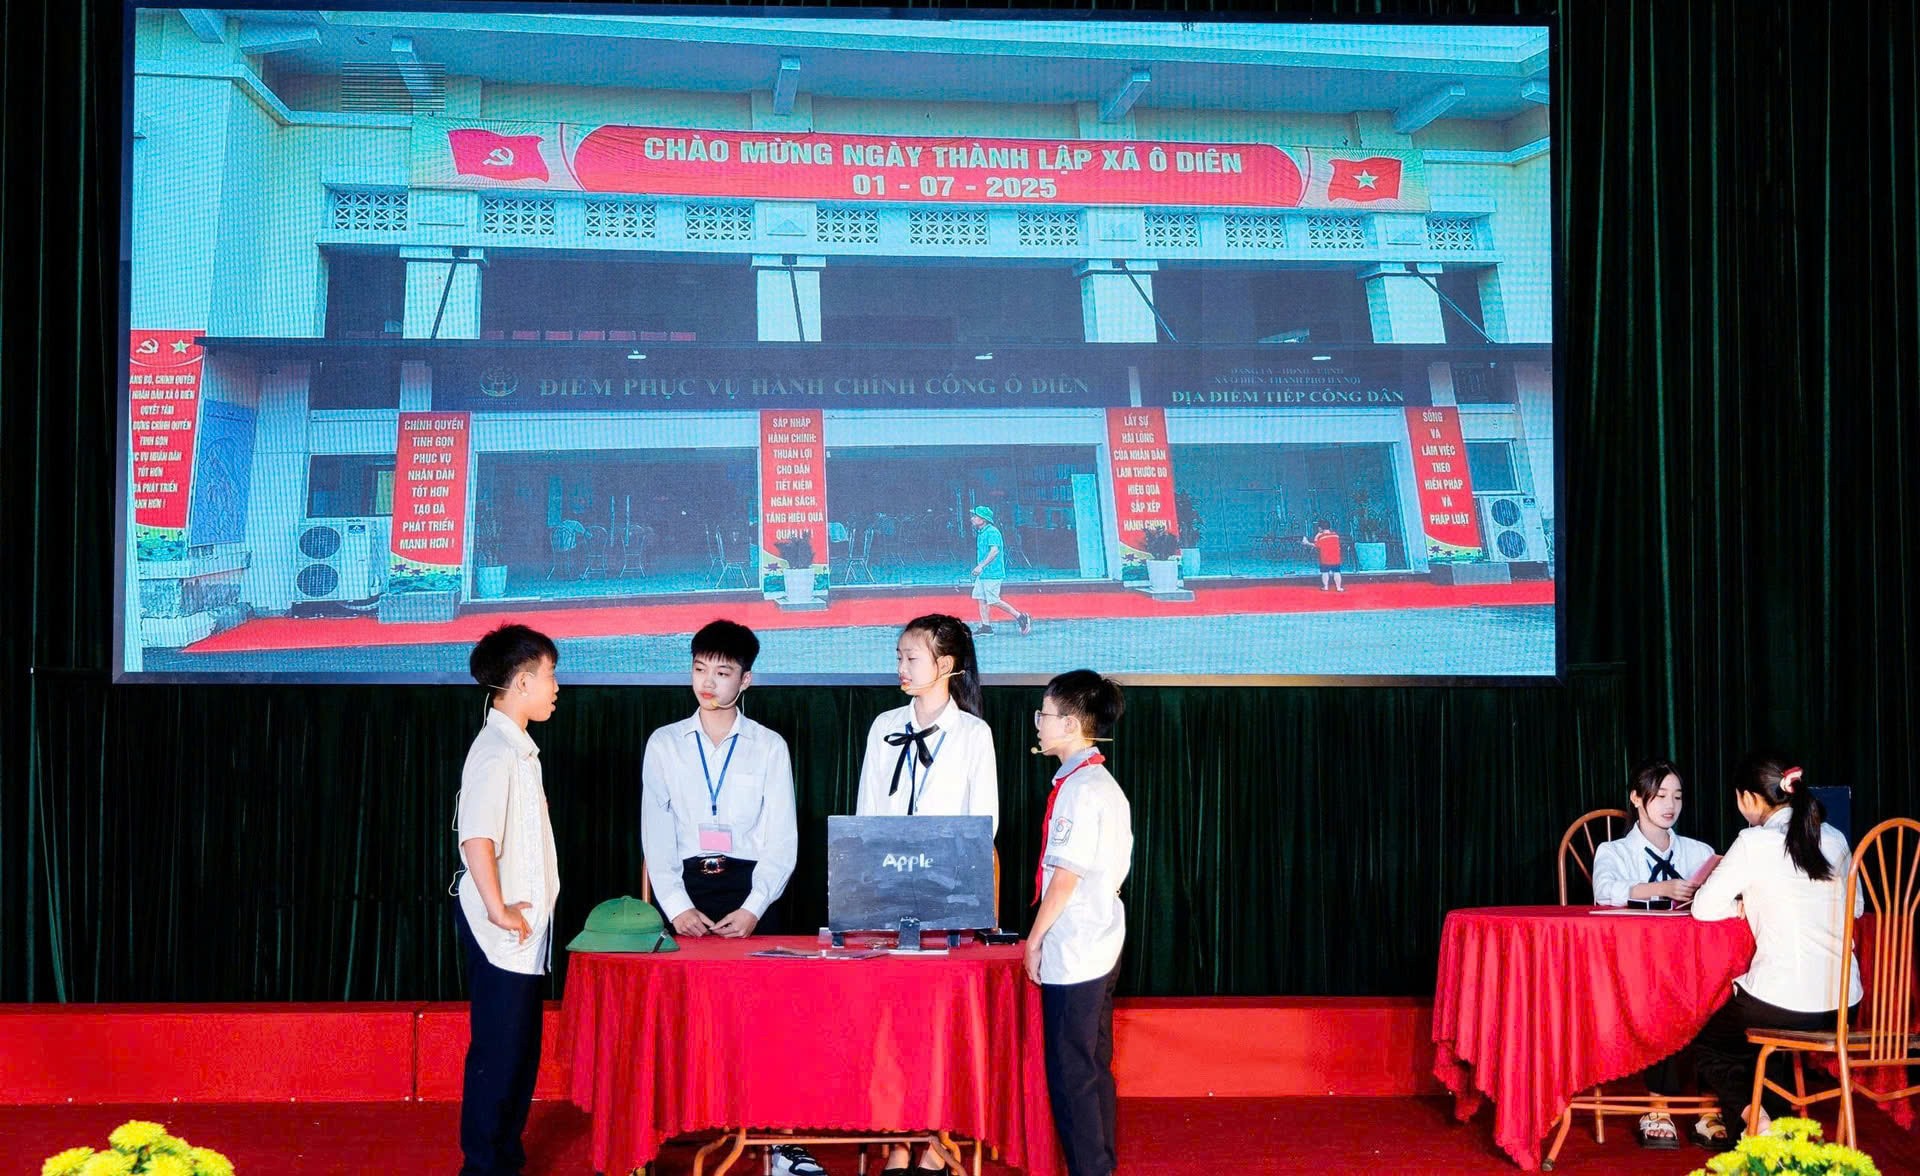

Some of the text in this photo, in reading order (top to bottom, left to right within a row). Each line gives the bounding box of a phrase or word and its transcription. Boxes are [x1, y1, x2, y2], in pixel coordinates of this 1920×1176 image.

[644, 135, 1241, 174] CHÀO MỪNG NGÀY THÀNH LẬP XÃ Ô DIÊN
[852, 174, 886, 196] 01
[920, 176, 954, 197] 07
[986, 177, 1057, 198] 2025
[623, 378, 696, 400] PHỤC
[705, 378, 741, 400] VỤ
[834, 375, 917, 395] CHÍNH
[925, 373, 996, 395] CÔNG
[1172, 391, 1207, 406] ĐỊA
[1309, 388, 1362, 403] CÔNG
[1367, 387, 1405, 403] DÂN
[1422, 408, 1443, 422] SỐNG
[404, 418, 432, 430] CHÍNH
[1430, 426, 1441, 439] VÀ
[435, 436, 454, 448] GỌN
[413, 453, 452, 465] PHỤC VỤ
[776, 464, 792, 475] CHO
[1431, 462, 1450, 473] THEO
[412, 484, 449, 498] TỐT HƠN
[413, 503, 430, 516] TẠO
[1430, 512, 1450, 525] PHÁP
[400, 538, 427, 552] MẠNH
[430, 537, 449, 549] HƠN
[882, 853, 934, 872] Apple
